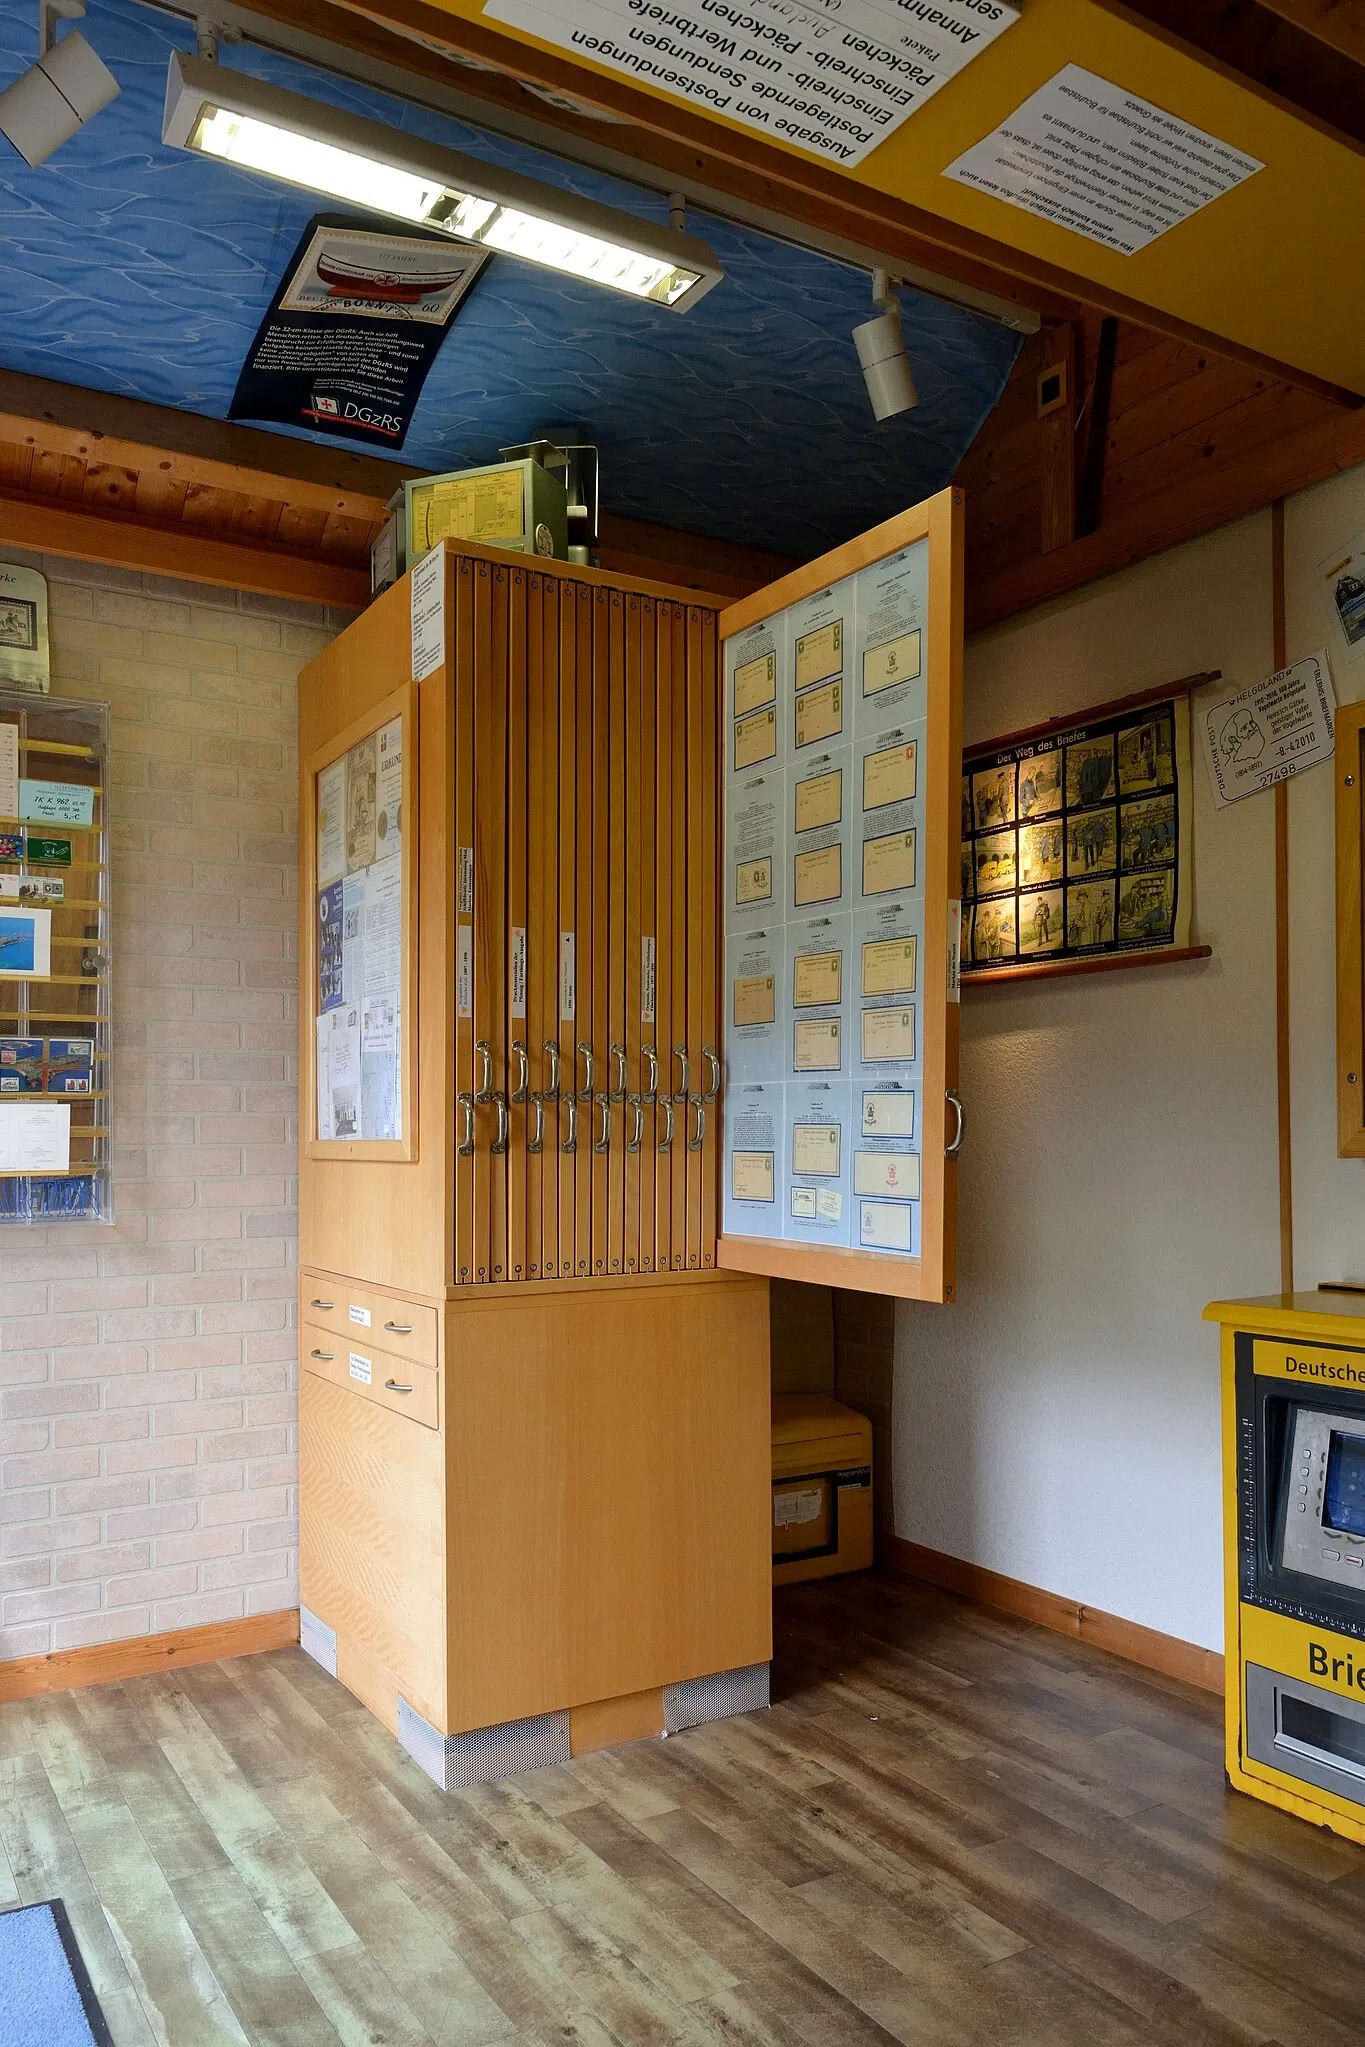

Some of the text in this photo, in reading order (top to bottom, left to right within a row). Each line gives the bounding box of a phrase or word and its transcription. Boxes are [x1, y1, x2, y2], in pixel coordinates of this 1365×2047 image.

[897, 0, 979, 42] Annahm
[701, 0, 913, 104] Einschreib- Päckchen
[900, 36, 939, 61] Pakete
[628, 0, 893, 124] Einschreib- und Wertbriefe
[842, 34, 934, 85] Päckchen
[629, 28, 872, 142] Postlagernde Sendungen
[572, 31, 855, 158] Ausgabe von Postsendungen
[1096, 105, 1109, 114] für
[1150, 115, 1163, 123] als
[1075, 130, 1087, 138] du
[1084, 135, 1100, 144] und
[959, 169, 979, 180] auch
[1109, 163, 1121, 171] am
[978, 178, 999, 190] lesen
[1106, 178, 1120, 186] das
[1226, 172, 1241, 182] Das
[999, 187, 1029, 203] drauflos
[1168, 191, 1183, 200] und
[1183, 183, 1200, 194] Rset
[1199, 191, 1213, 200] Der
[1029, 201, 1056, 216] Einfach
[1061, 206, 1091, 222] komisch
[1075, 222, 1092, 231] alles
[1090, 219, 1113, 232] wenns
[1106, 236, 1119, 244] das
[1119, 242, 1134, 252] Was
[344, 300, 385, 309] BONN
[422, 303, 440, 312] 60
[360, 364, 386, 374] Spenden
[372, 360, 393, 368] DGzRS
[384, 375, 404, 384] Arbeit.
[344, 403, 402, 432] DGzRS
[1236, 671, 1285, 704] HELGOLAND
[1258, 683, 1306, 713] Vogelwarte Helgoland
[1266, 705, 1288, 722] Heinrich
[1270, 703, 1310, 728] geistiger Vater
[1319, 697, 1335, 739] BRIEFMARKEN
[1272, 711, 1313, 735] der Vogelwarte
[997, 730, 1086, 765] Der Weg des Briefes
[1207, 725, 1225, 790] DEUTSCHE POST
[1260, 763, 1297, 788] 27498
[1286, 1357, 1365, 1383] Deutsche
[1309, 1641, 1365, 1692] Brie
